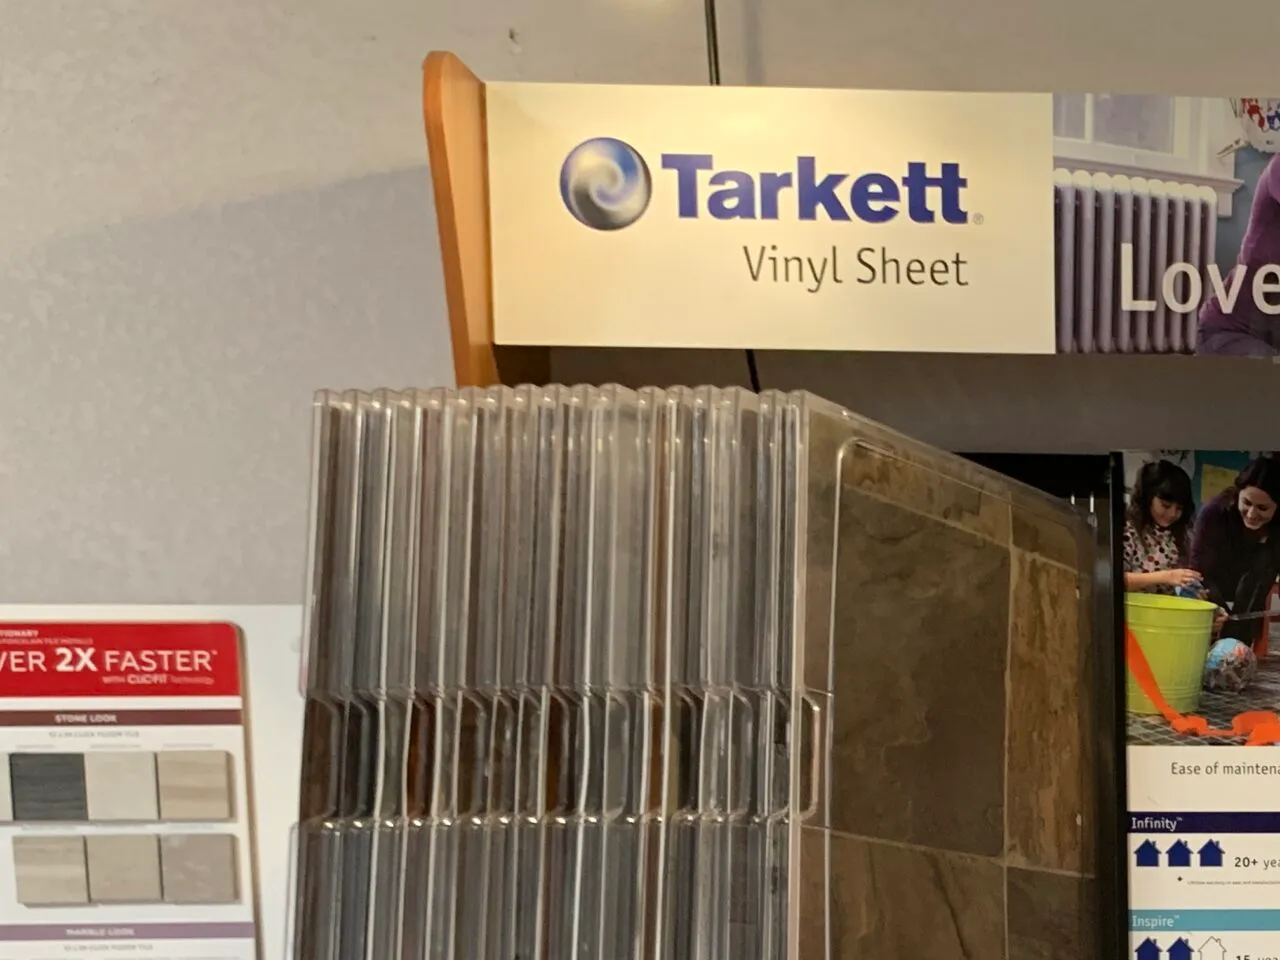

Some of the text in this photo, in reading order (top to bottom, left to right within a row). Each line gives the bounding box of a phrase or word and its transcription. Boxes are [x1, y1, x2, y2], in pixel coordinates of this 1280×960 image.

[661, 153, 969, 224] Tarkett
[742, 245, 969, 293] Vinyl Sheet
[55, 647, 98, 672] 2X
[55, 714, 118, 723] STONE LOOK
[1171, 762, 1202, 776] Ease
[1205, 761, 1219, 775] of
[1234, 856, 1259, 869] 20+
